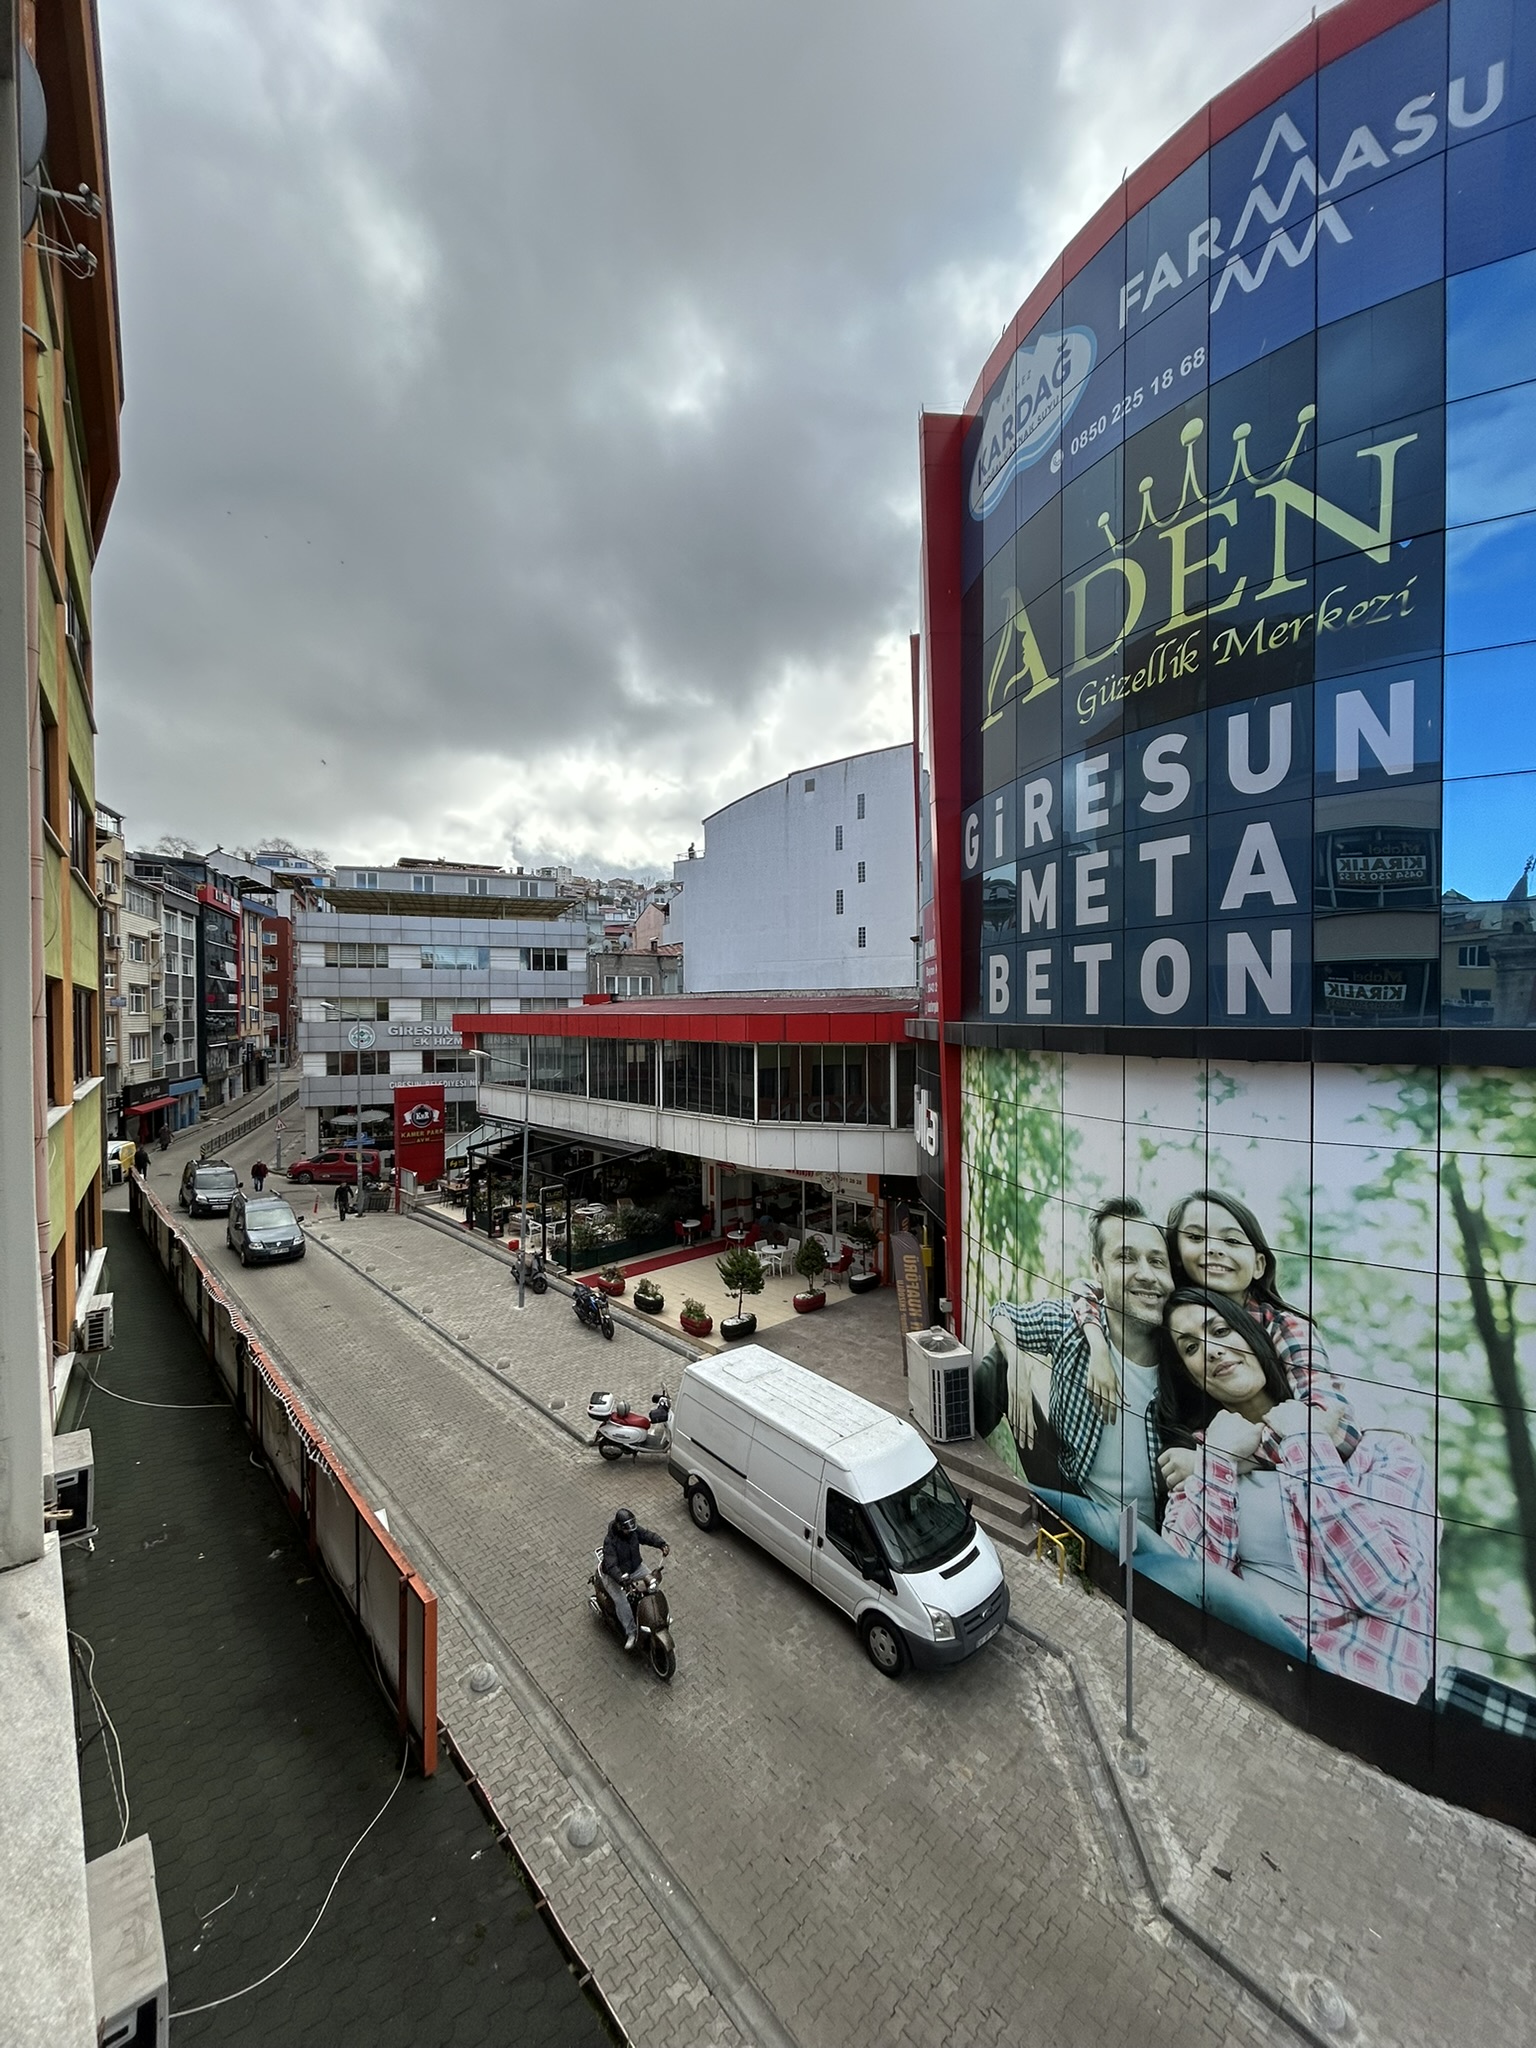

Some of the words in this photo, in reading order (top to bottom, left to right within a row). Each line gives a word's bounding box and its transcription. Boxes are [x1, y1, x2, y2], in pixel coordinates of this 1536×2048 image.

[976, 337, 1072, 487] KARDAĞ
[1070, 415, 1107, 456] 0850
[1111, 387, 1144, 425] 225
[1150, 367, 1174, 396] 18
[1179, 346, 1206, 377] 68
[980, 432, 1419, 732] ADEN
[1075, 629, 1201, 724] Güzellik
[1212, 574, 1419, 666] Merkezi
[1020, 821, 1298, 934] META
[988, 929, 1293, 1015] BETON
[427, 1128, 445, 1136] PARK
